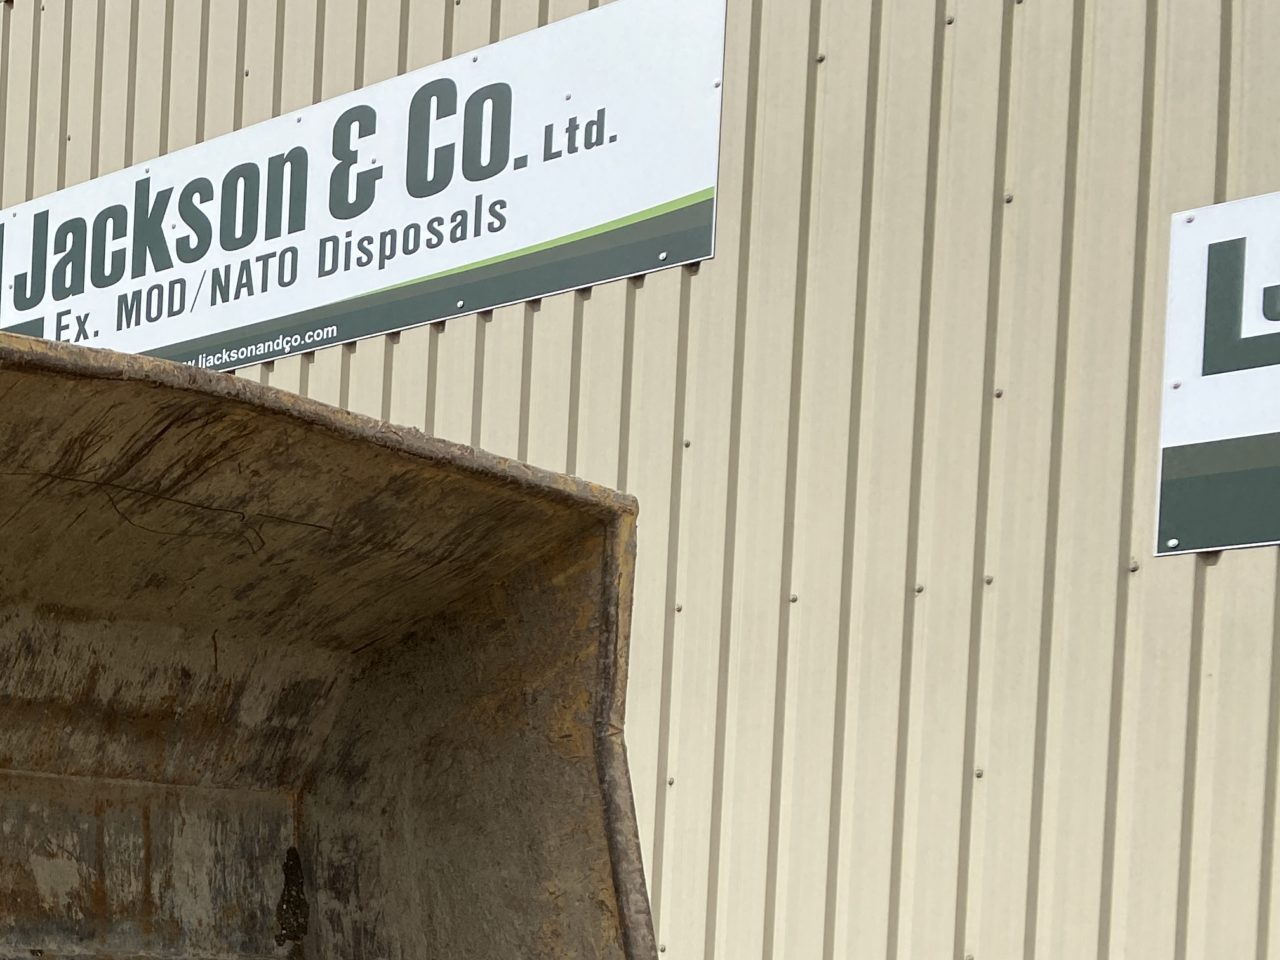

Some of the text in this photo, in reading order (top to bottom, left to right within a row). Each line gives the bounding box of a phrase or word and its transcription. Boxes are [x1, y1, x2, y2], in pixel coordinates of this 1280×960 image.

[13, 146, 309, 311] Jackson
[329, 105, 384, 220] &
[406, 78, 528, 199] Co.
[543, 108, 618, 162] Ltd.
[55, 194, 507, 343] Ex. MOD/NATO Disposals
